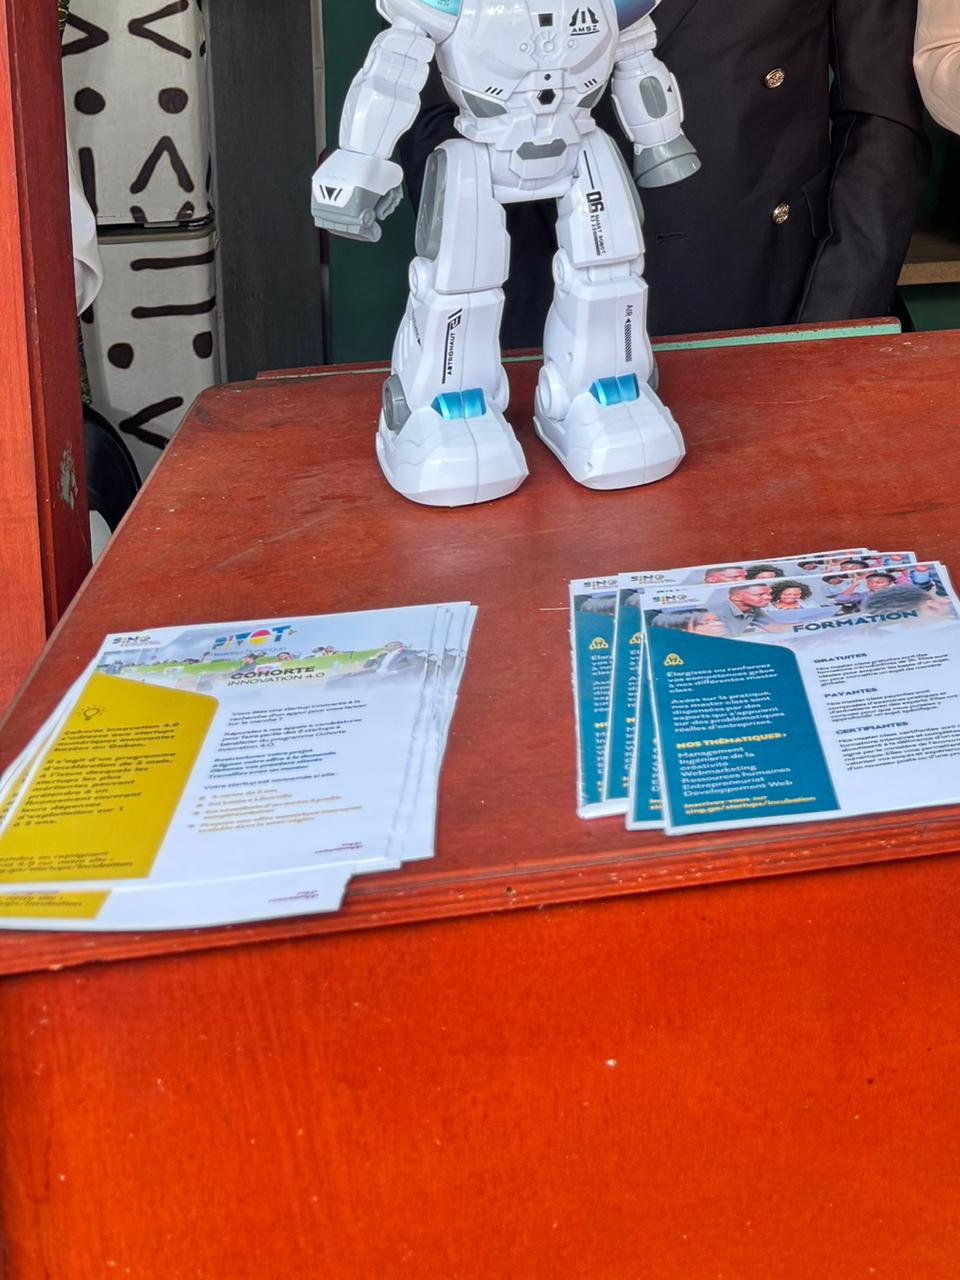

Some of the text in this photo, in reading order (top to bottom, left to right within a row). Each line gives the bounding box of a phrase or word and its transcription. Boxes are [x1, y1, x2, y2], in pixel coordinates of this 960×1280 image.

[572, 24, 598, 33] AMSZ
[586, 191, 604, 213] 06
[792, 609, 918, 634] FORMATION
[212, 624, 291, 650] PIVOT
[812, 652, 867, 663] GRATUITES
[677, 746, 744, 759] Management
[680, 764, 757, 777] Webmarketing
